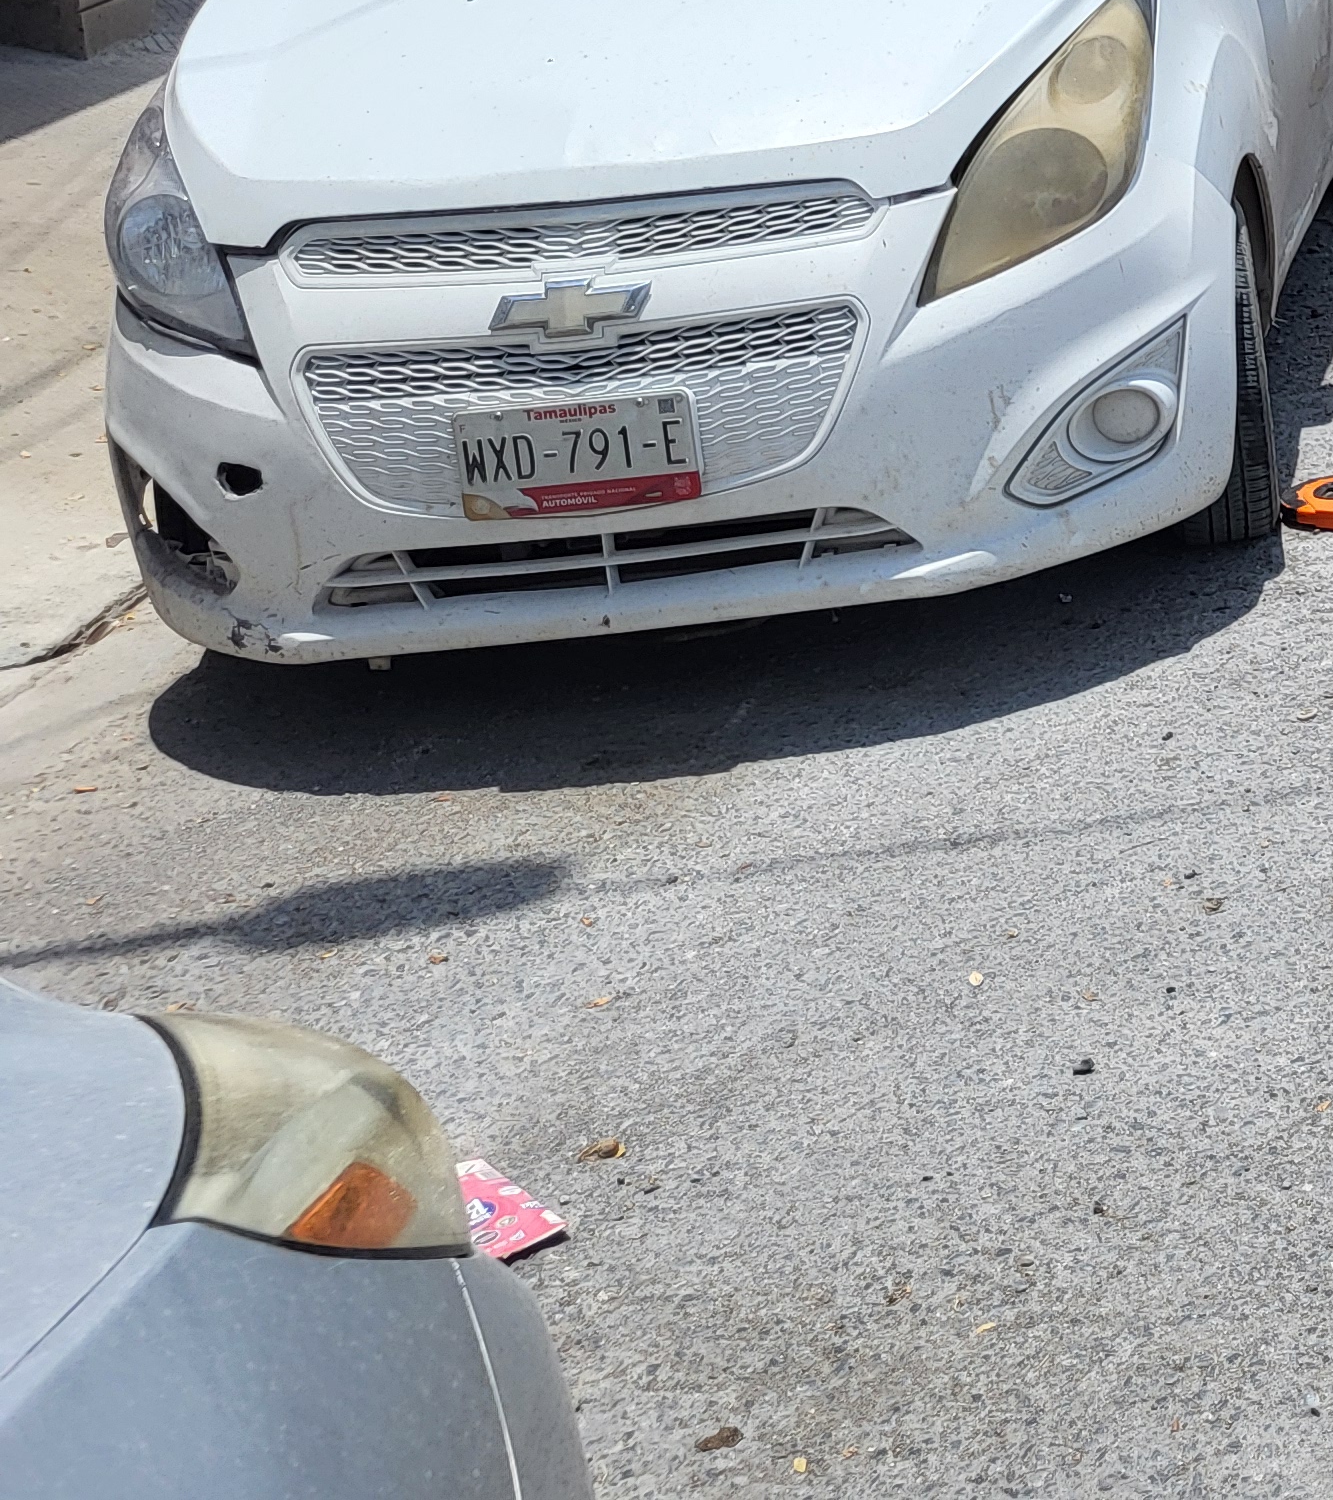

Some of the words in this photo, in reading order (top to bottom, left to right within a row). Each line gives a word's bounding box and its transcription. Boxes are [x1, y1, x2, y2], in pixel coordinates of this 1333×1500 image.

[522, 403, 618, 422] Tamaulipas
[461, 419, 689, 486] WXD-791-E
[541, 495, 599, 509] AUTOMÓVIL
